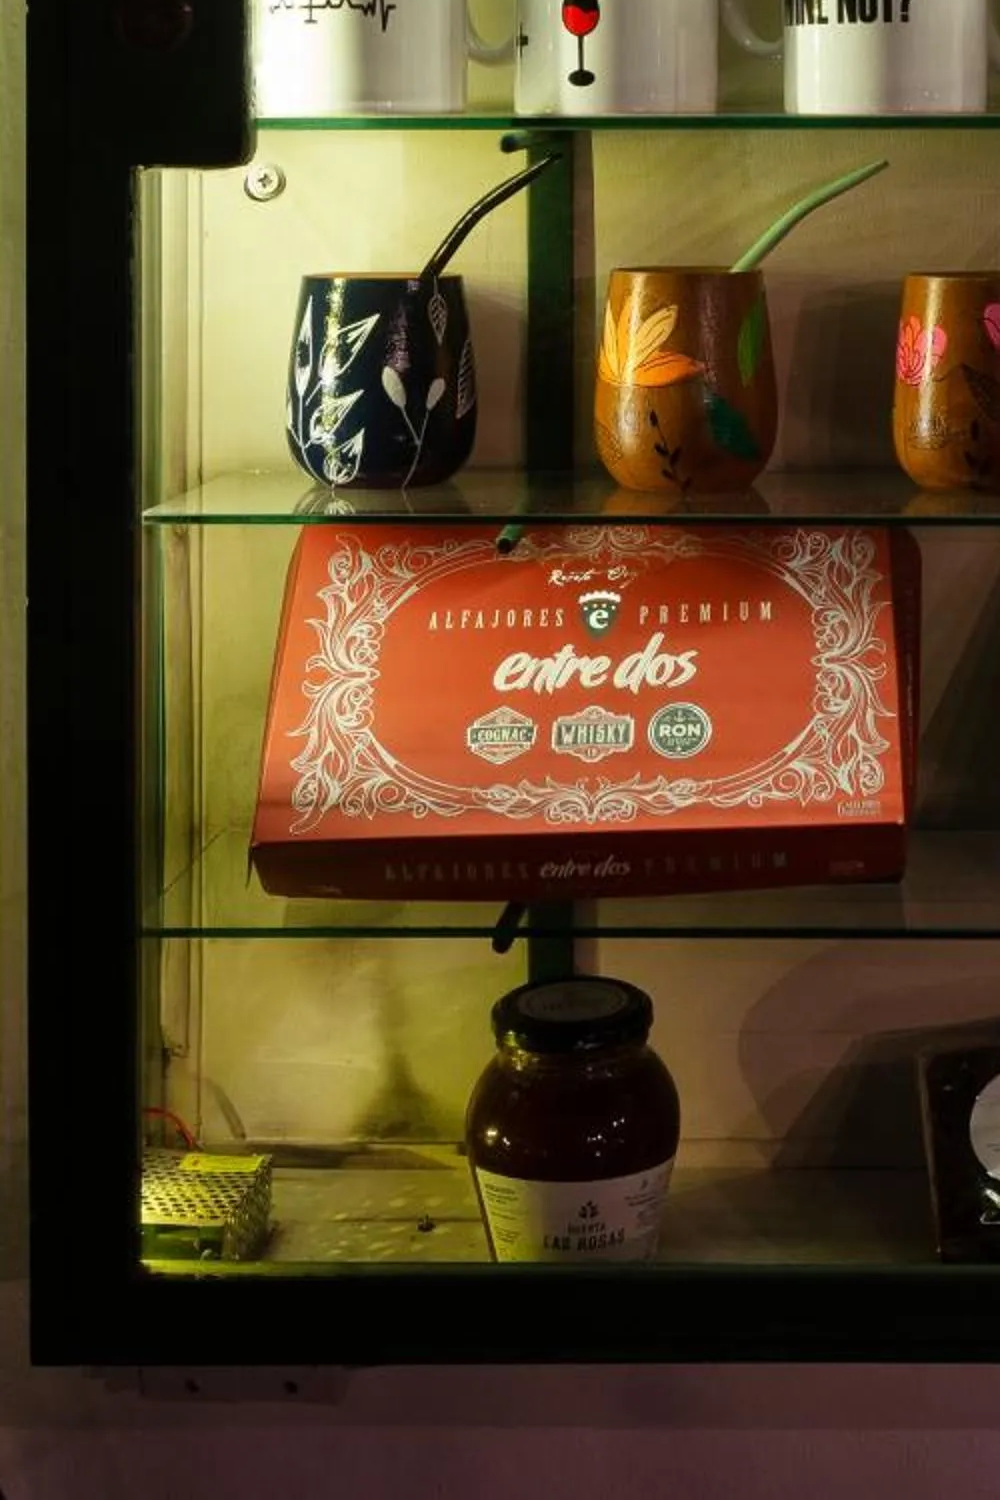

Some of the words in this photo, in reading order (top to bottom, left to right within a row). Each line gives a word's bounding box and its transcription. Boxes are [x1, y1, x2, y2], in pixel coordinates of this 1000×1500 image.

[428, 607, 565, 631] ALFAJORES
[639, 600, 773, 626] PREMIUM
[492, 643, 612, 695] entre
[613, 631, 699, 695] dos
[477, 727, 528, 741] COGNAC
[561, 723, 626, 744] WHISKY
[659, 724, 701, 737] RON
